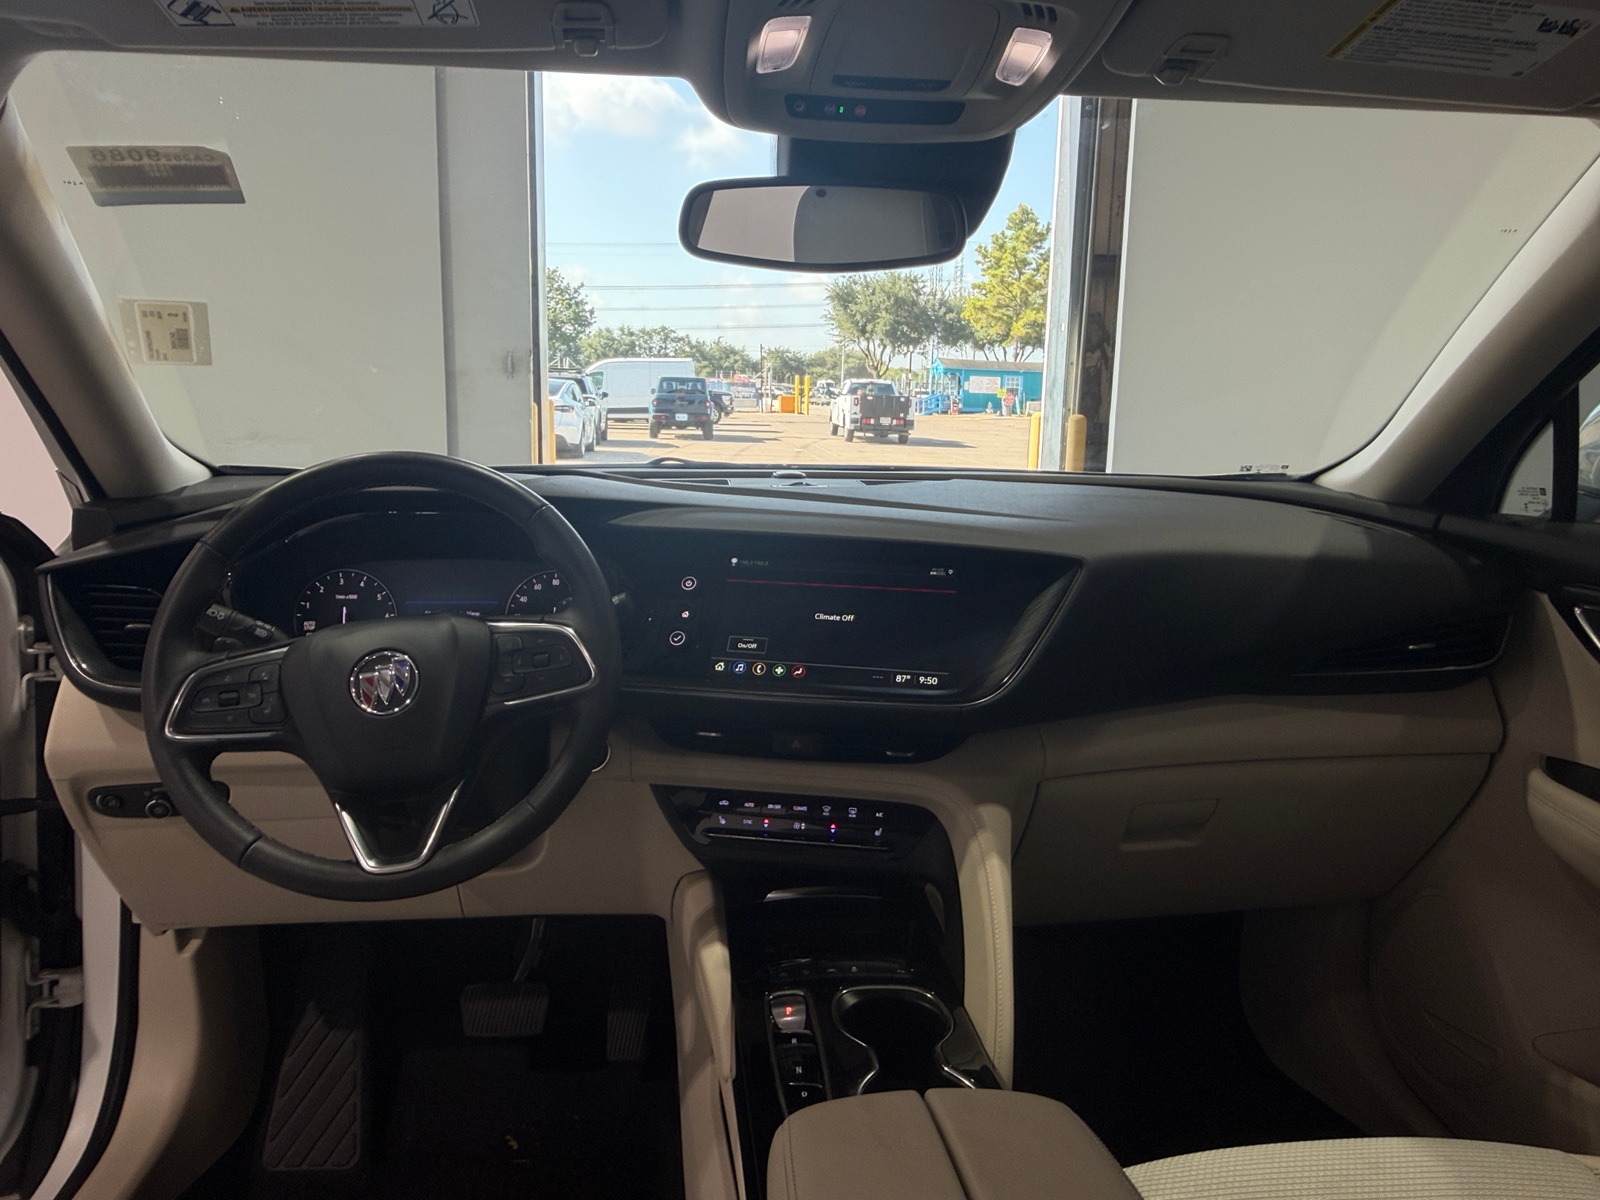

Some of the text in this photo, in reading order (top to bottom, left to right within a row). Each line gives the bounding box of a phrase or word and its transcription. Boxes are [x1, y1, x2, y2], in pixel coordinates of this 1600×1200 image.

[533, 583, 542, 591] 60
[519, 595, 528, 603] 40
[814, 613, 854, 622] Climate Off
[737, 642, 757, 650] On/Off
[895, 674, 911, 683] 87°
[919, 676, 938, 685] 9:50
[786, 1006, 792, 1015] P
[796, 1066, 802, 1074] N
